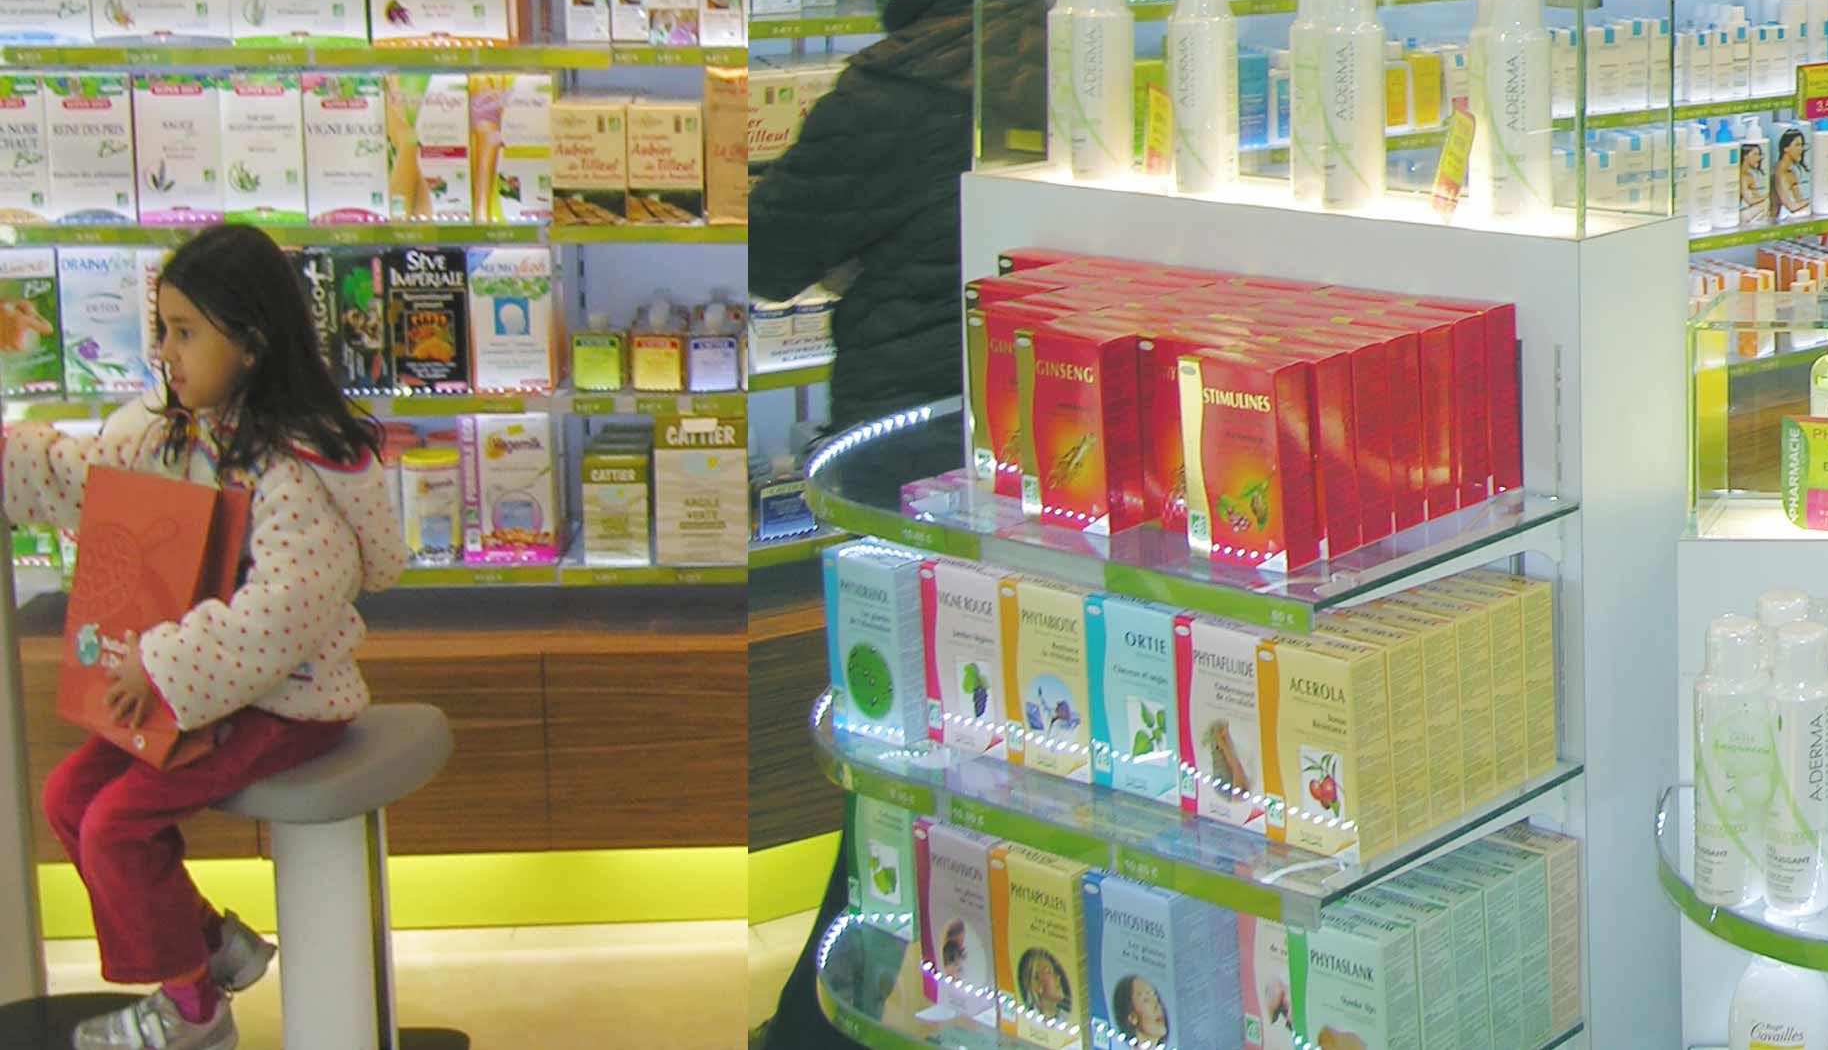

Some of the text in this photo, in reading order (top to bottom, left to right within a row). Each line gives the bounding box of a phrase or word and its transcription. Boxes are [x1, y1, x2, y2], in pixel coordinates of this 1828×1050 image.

[1036, 360, 1095, 384] GINSENG
[1202, 387, 1272, 413] STIMULINES
[1786, 428, 1801, 514] PHARMACIE
[1125, 630, 1168, 654] ORTIE
[1289, 676, 1346, 704] ACEROLA
